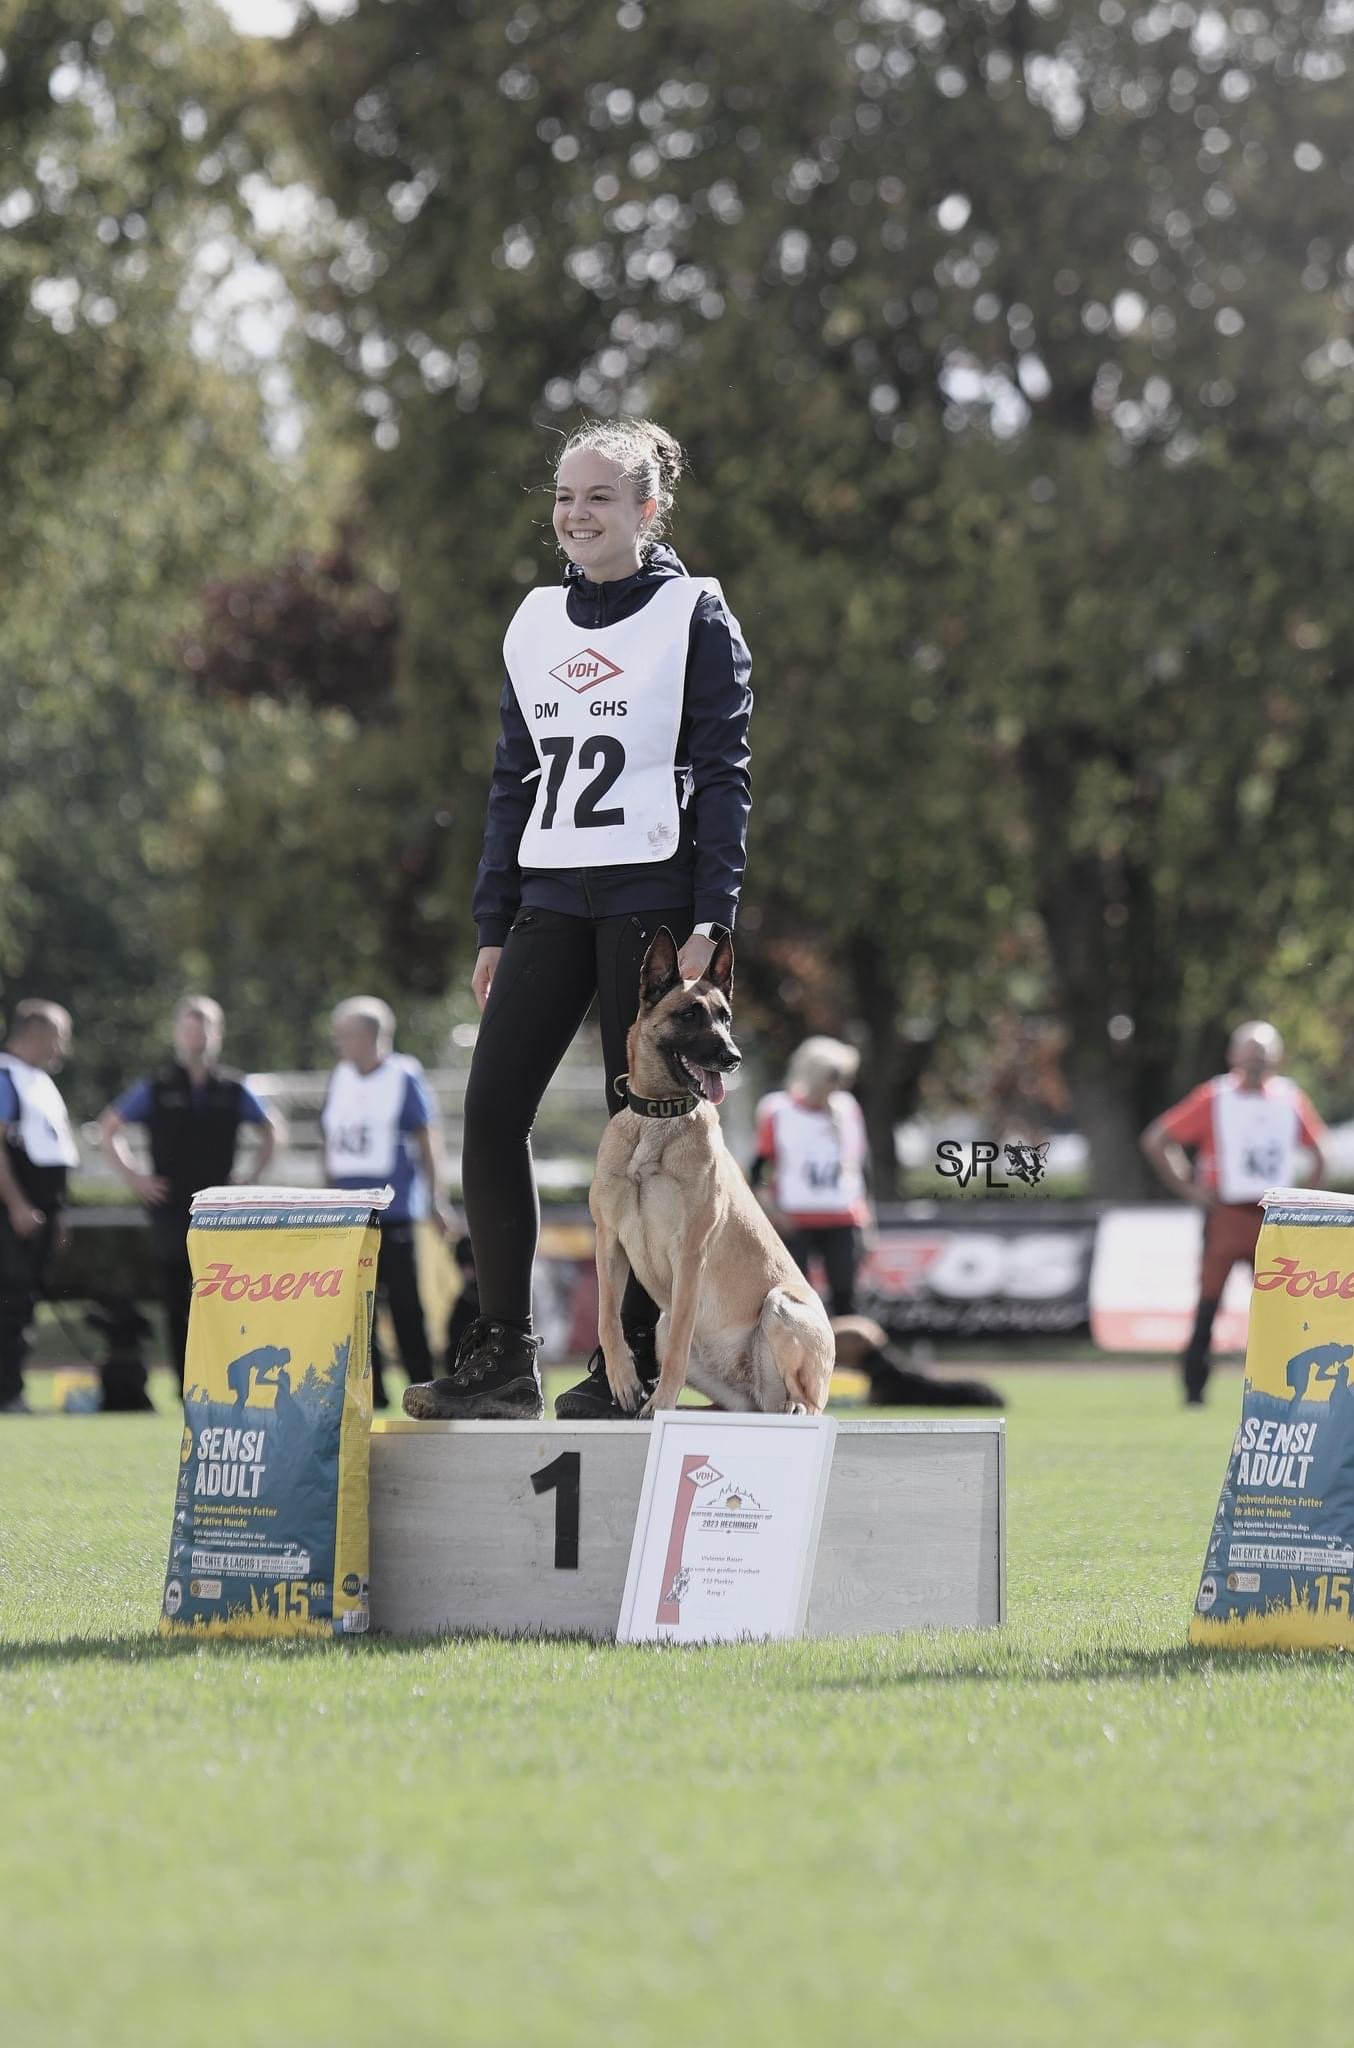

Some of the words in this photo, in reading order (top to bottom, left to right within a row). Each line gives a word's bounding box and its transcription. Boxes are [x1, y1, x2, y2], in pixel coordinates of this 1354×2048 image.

[567, 662, 599, 678] VDH
[534, 702, 559, 719] DM
[589, 700, 628, 716] GHS
[539, 734, 626, 830] 72
[197, 1216, 218, 1226] SUPER
[217, 1216, 248, 1226] PREMIUM
[248, 1216, 261, 1225] PET
[261, 1215, 277, 1225] FOOD
[287, 1215, 305, 1225] MADE
[305, 1215, 313, 1224] IN
[313, 1214, 345, 1224] GERMANY
[1267, 1212, 1289, 1221] SUPER
[1288, 1213, 1320, 1222] PREMIUM
[1320, 1214, 1334, 1222] PET
[1334, 1214, 1354, 1224] FOOD
[195, 1263, 344, 1302] Josera
[1241, 1416, 1318, 1454] SENSI
[197, 1427, 266, 1463] SENSI
[695, 1471, 714, 1480] VDH
[1236, 1451, 1314, 1489] ADULT
[193, 1462, 266, 1498] ADULT
[530, 1451, 580, 1569] 1
[1298, 1497, 1323, 1508] Futter
[253, 1506, 278, 1517] Futter
[1243, 1508, 1265, 1517] aktive
[1266, 1508, 1292, 1519] Hunde
[202, 1517, 223, 1526] aktive
[223, 1518, 248, 1528] Hunde
[702, 1519, 719, 1529] 2023
[720, 1521, 758, 1530] HECHINGEN
[192, 1553, 203, 1564] MIT
[204, 1554, 222, 1566] ENTE
[222, 1555, 230, 1567] &
[229, 1556, 256, 1569] LACHS
[1231, 1547, 1243, 1559] MIT
[1243, 1548, 1262, 1560] ENTE
[1263, 1549, 1271, 1560] &
[1271, 1550, 1297, 1561] LACHS
[273, 1581, 310, 1622] 15
[310, 1583, 326, 1597] KG
[1314, 1575, 1351, 1617] 15
